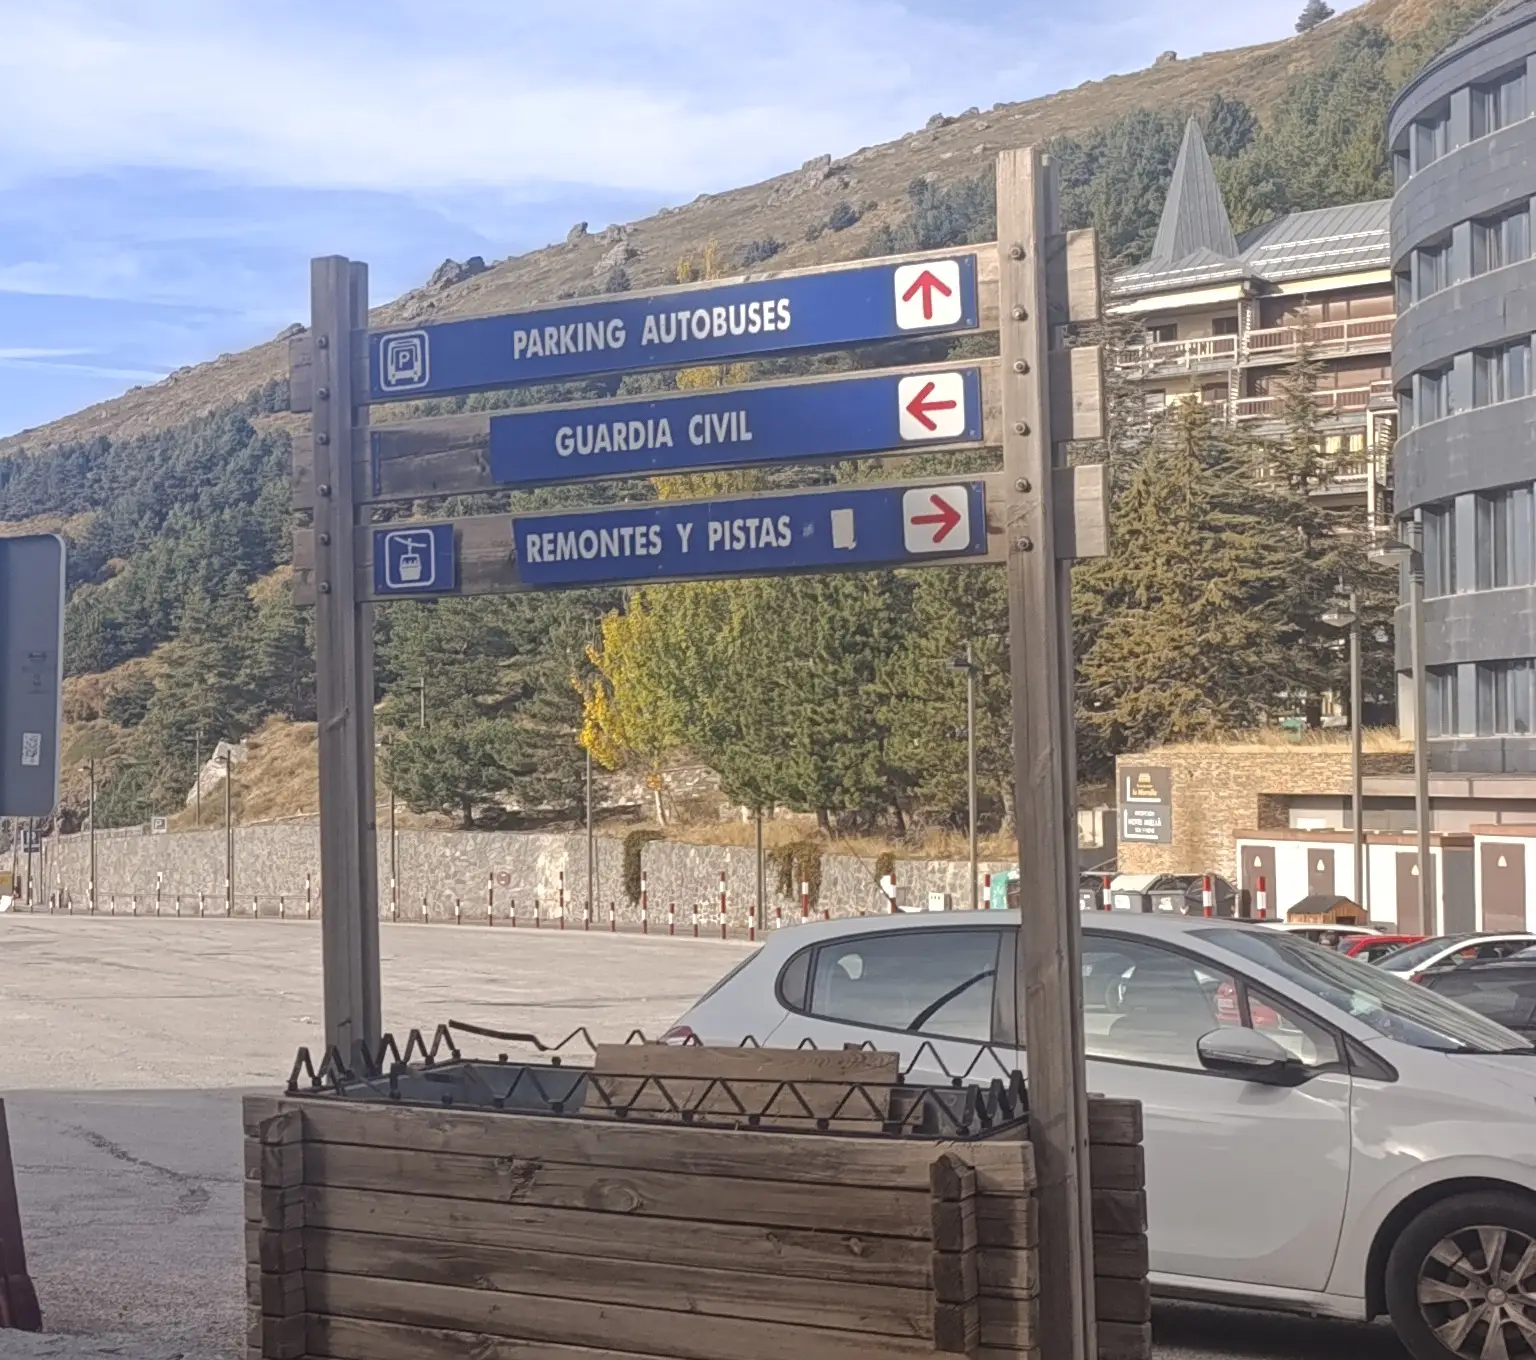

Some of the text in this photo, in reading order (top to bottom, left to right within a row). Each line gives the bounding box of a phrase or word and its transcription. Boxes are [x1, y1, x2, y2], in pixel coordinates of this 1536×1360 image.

[513, 298, 791, 360] PARKING AUTOBUSES
[398, 351, 410, 368] P
[555, 410, 752, 457] GUARDIA CIVIL
[526, 515, 792, 563] REMONTES Y PISTAS
